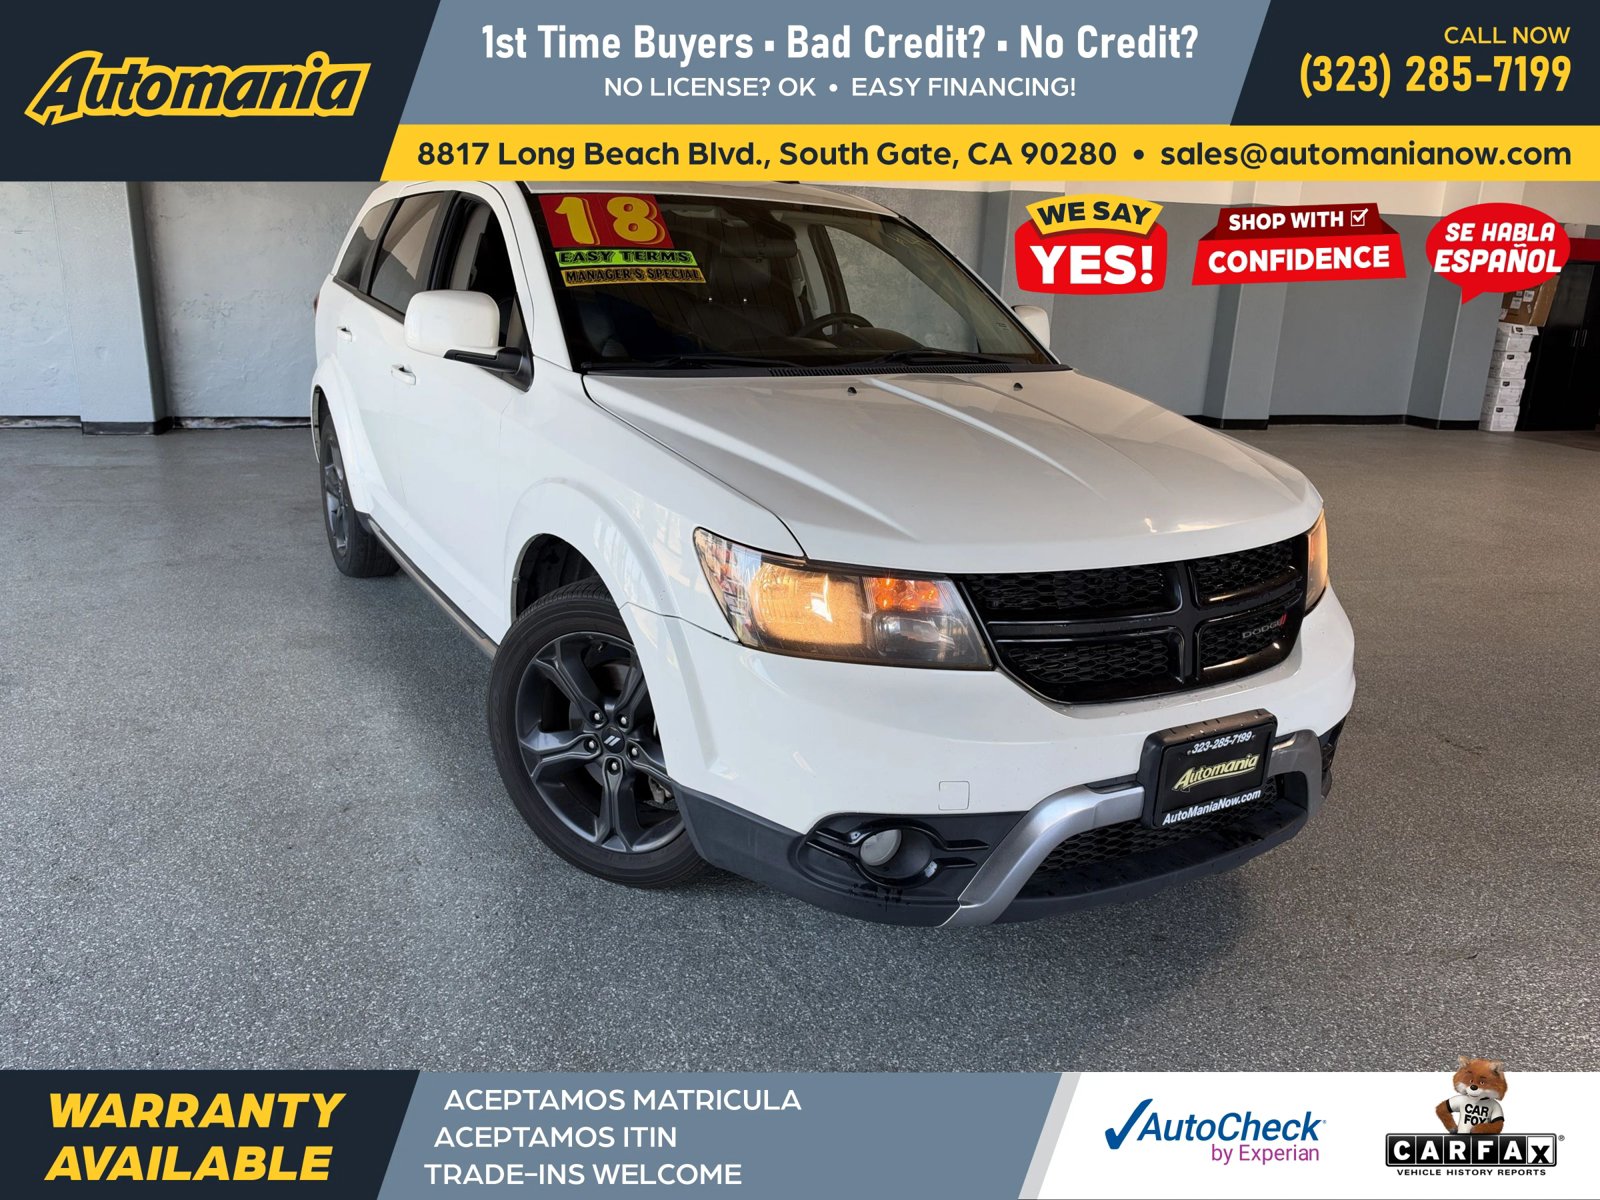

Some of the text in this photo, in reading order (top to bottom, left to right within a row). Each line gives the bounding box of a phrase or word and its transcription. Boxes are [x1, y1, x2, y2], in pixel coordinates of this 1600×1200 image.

[555, 196, 665, 245] 18
[559, 250, 692, 265] EASY TERMS
[565, 268, 703, 284] MANAGER'S SPECIAL
[1191, 731, 1253, 755] 323-285-7199
[1172, 753, 1261, 791] Automania
[1161, 789, 1262, 826] AutoManiaNow.com
